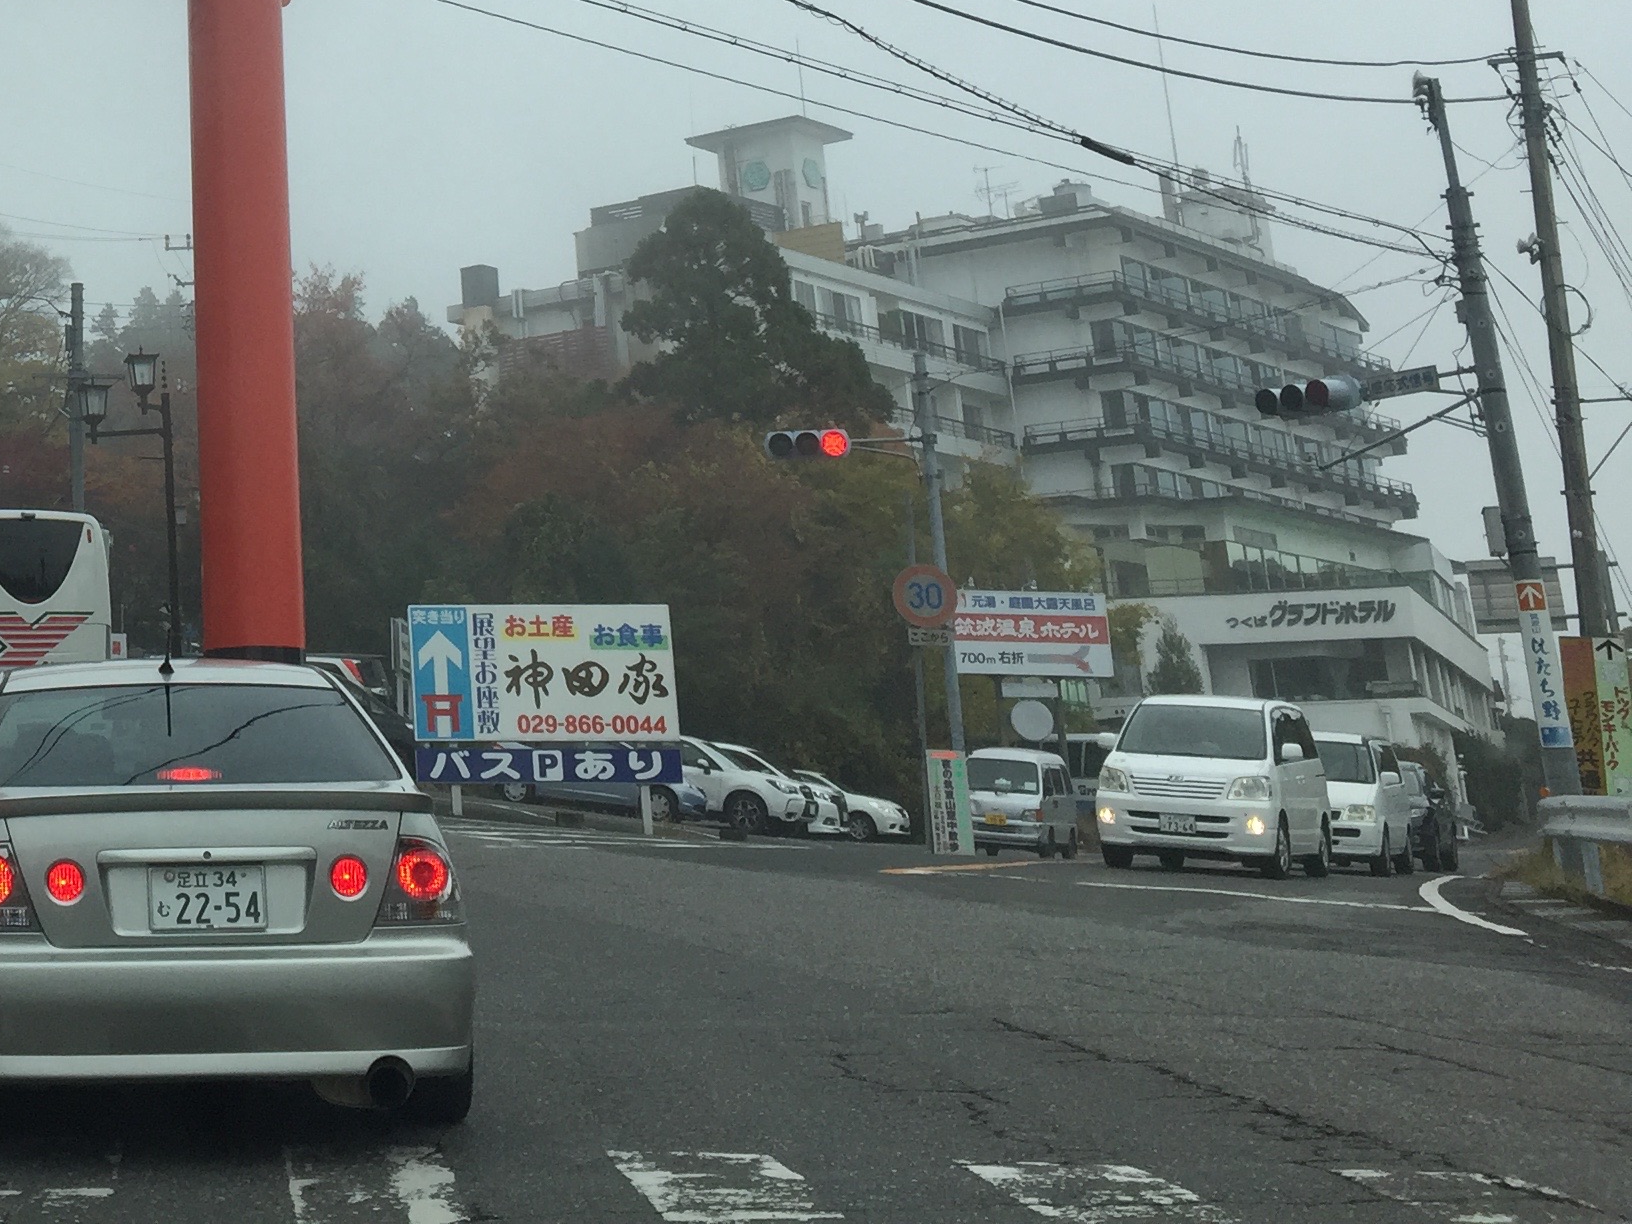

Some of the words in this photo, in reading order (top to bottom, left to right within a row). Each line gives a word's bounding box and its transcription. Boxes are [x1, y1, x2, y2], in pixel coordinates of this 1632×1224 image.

[908, 582, 943, 610] 30
[412, 609, 465, 625] 突き当り
[504, 614, 575, 638] お土産
[593, 623, 664, 647] お食事
[911, 631, 949, 643] ここから
[960, 652, 996, 664] 700m
[998, 651, 1024, 665] 右折
[472, 612, 500, 734] 展望お座敷
[504, 648, 669, 710] 神田家
[517, 714, 667, 734] 029-866-0044
[327, 819, 389, 830] ALTEZZA
[177, 871, 208, 888] 足立
[212, 870, 238, 887] 34
[157, 901, 171, 918] む
[175, 891, 261, 925] 22-54
